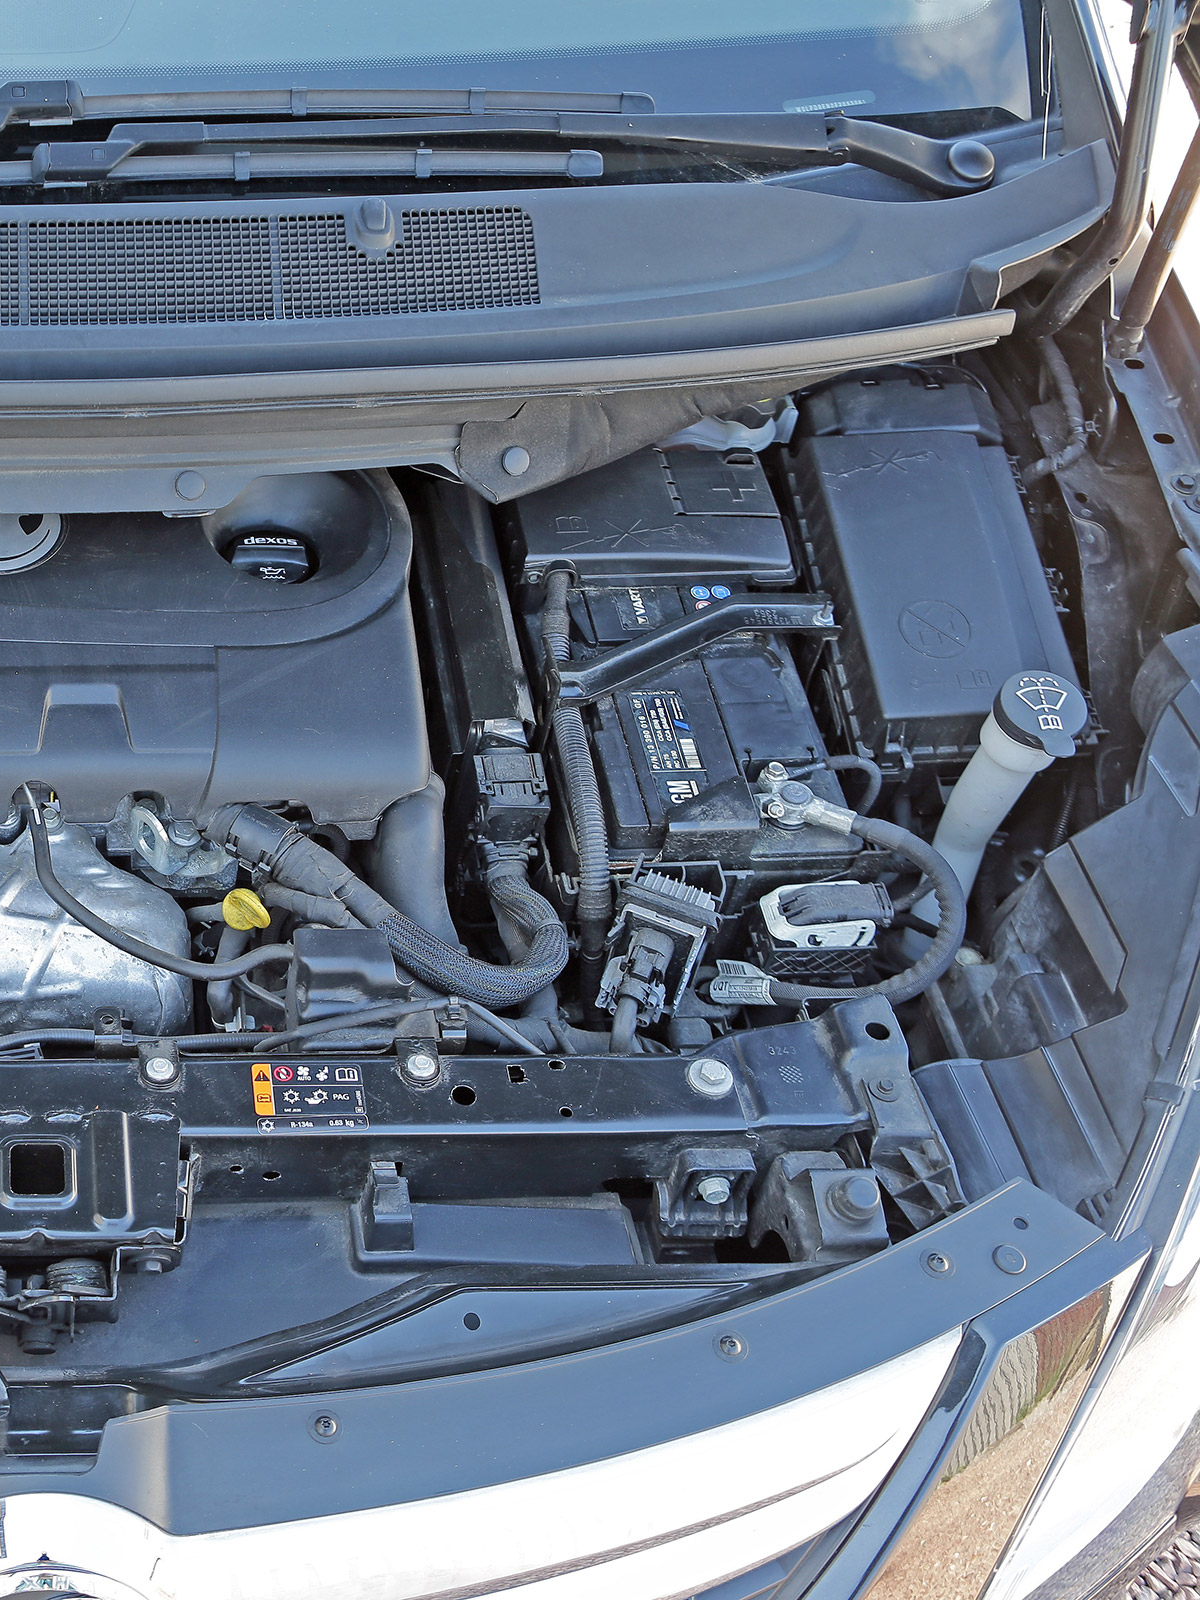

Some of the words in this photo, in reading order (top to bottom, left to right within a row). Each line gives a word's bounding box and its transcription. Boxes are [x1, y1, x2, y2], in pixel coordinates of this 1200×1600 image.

[243, 536, 298, 545] dexos
[628, 587, 646, 616] VART
[643, 729, 652, 743] 390
[663, 730, 673, 742] CCA
[646, 744, 656, 753] 13
[650, 756, 660, 769] P/N
[666, 780, 693, 804] GM
[345, 1119, 355, 1128] kg
